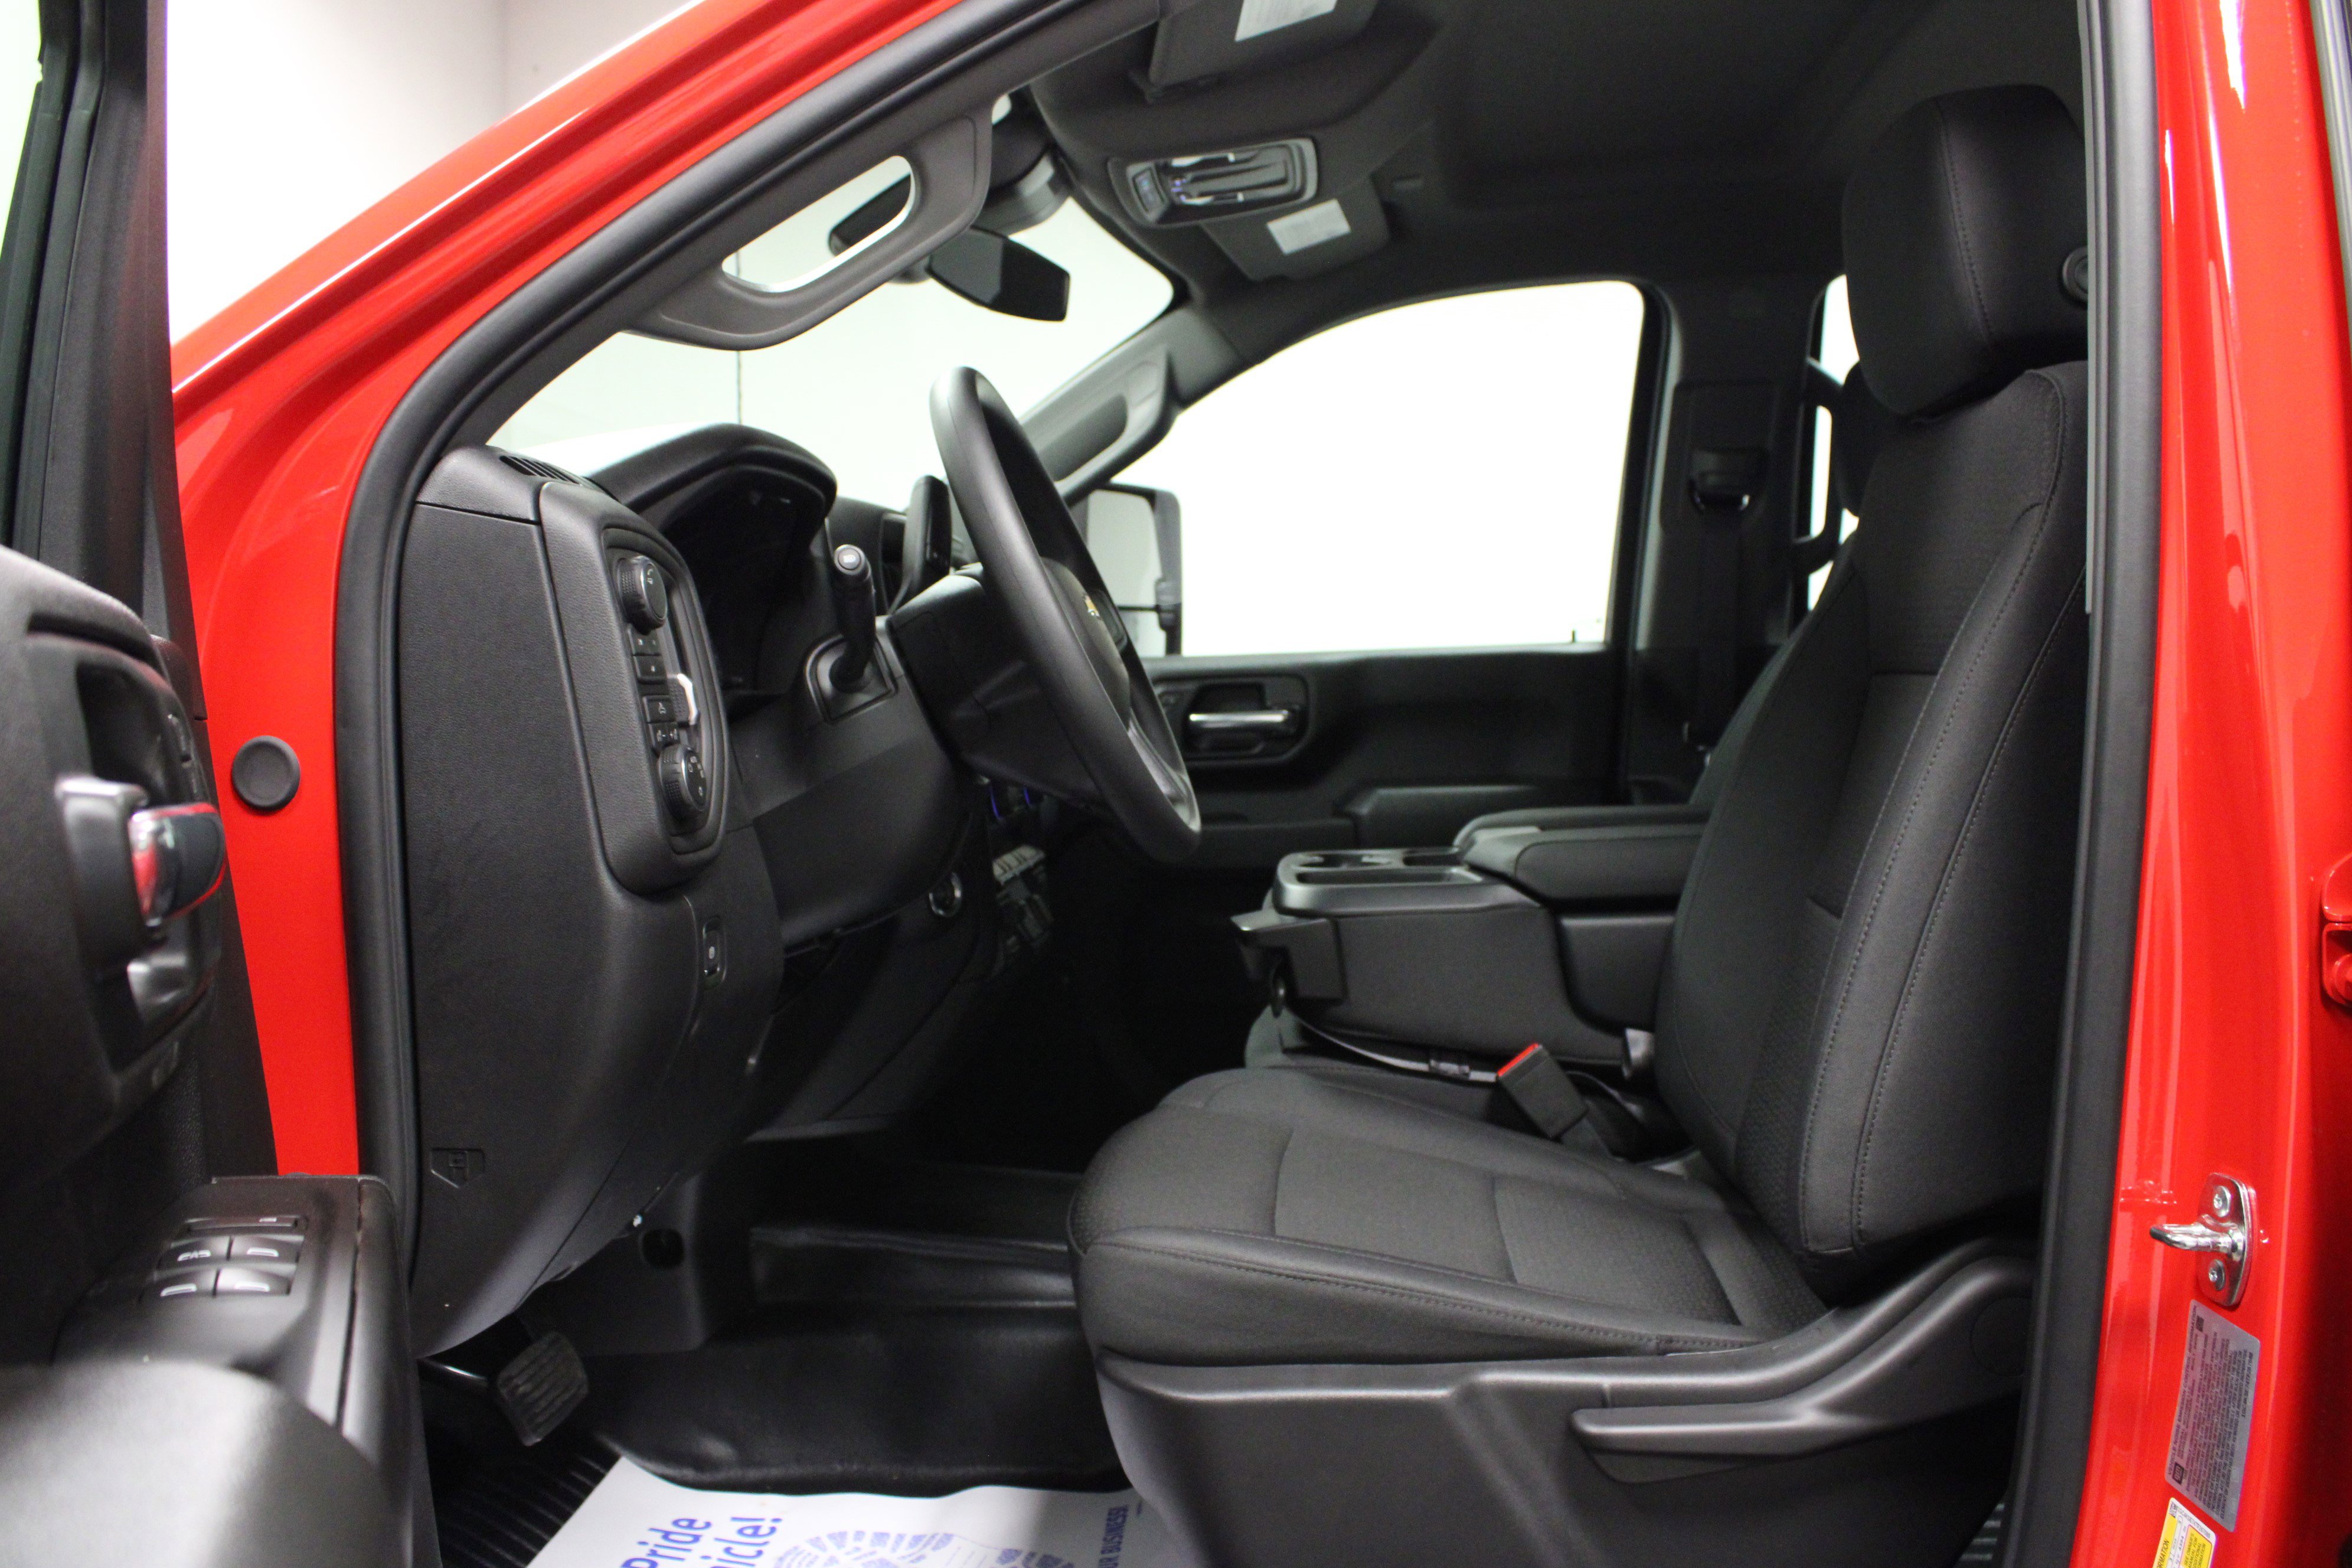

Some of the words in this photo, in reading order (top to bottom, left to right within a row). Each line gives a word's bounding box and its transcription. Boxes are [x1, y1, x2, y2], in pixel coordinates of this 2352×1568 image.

[2186, 1304, 2199, 1353] INFORMATION
[2183, 1355, 2191, 1389] CONTROL
[2177, 1388, 2186, 1423] EMISSION
[2168, 1445, 2176, 1476] VEHICLE
[621, 1517, 712, 1568] Pride
